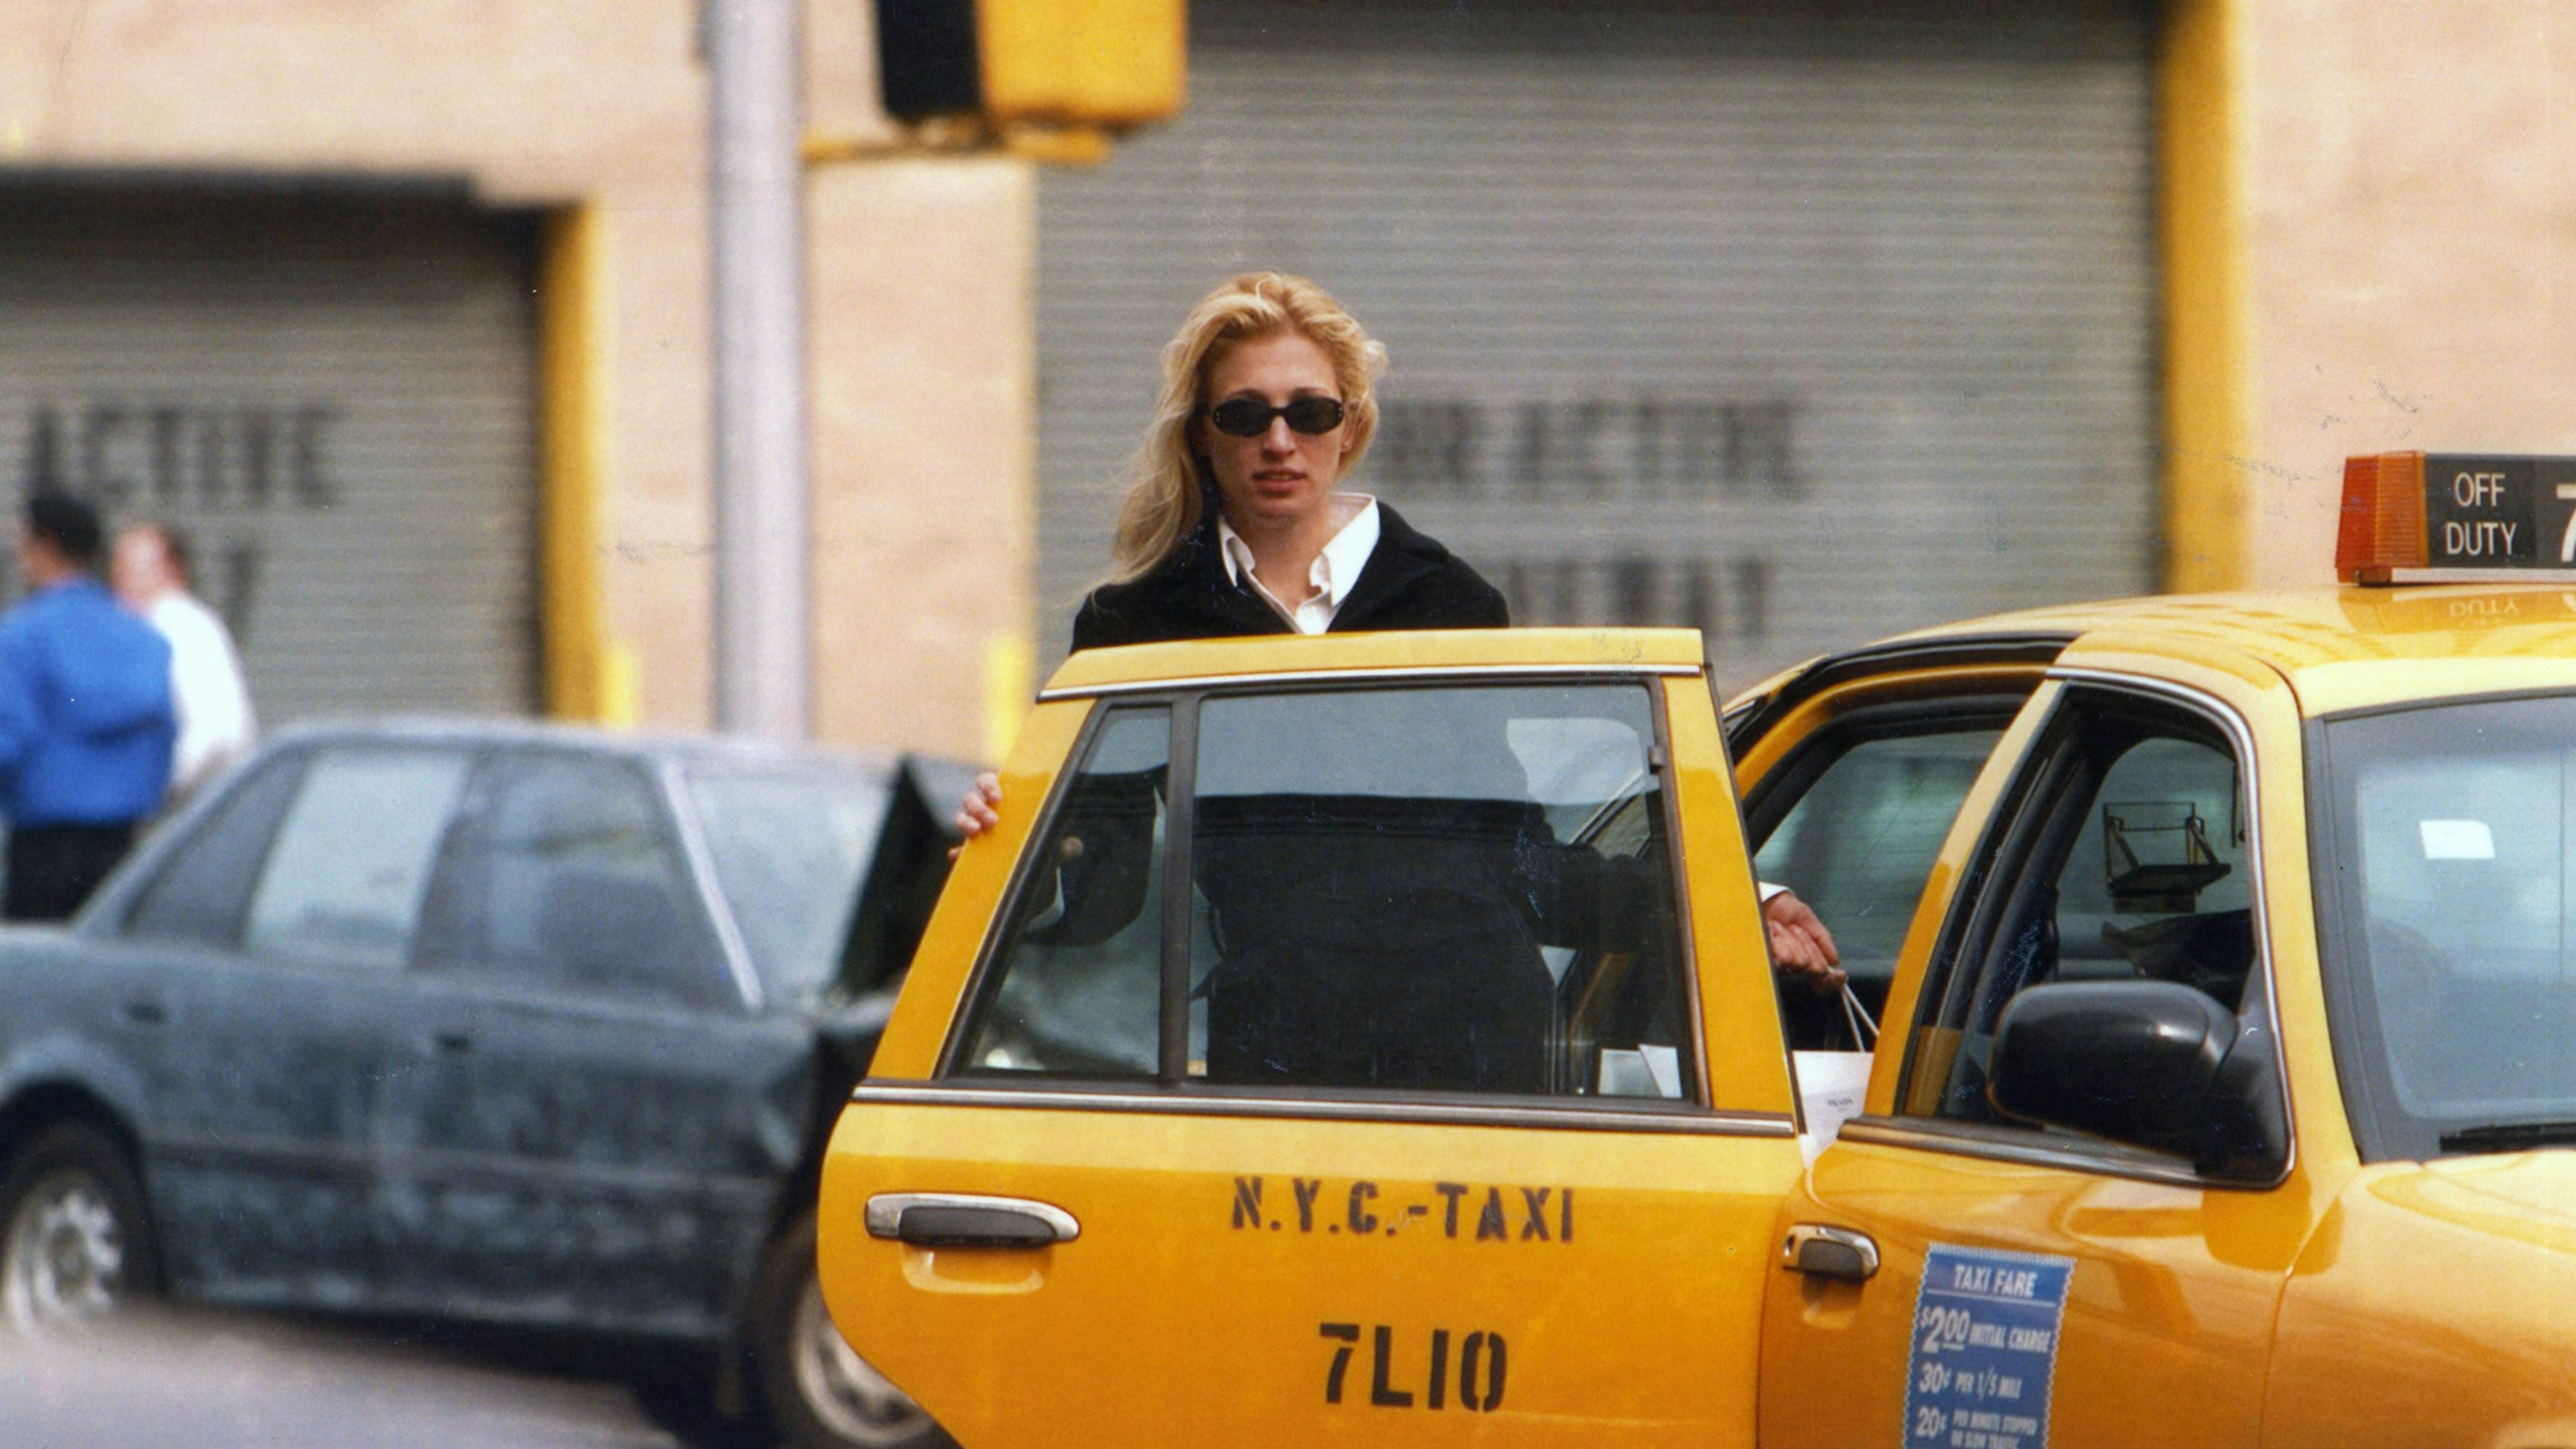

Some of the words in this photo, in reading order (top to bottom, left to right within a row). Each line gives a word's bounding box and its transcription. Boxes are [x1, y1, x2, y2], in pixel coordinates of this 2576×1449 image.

[2454, 471, 2506, 507] OFF
[2444, 521, 2517, 555] DUTY
[1954, 1264, 1991, 1292] TAXI
[1994, 1269, 2038, 1298] FARE
[1955, 1370, 1975, 1394] PER
